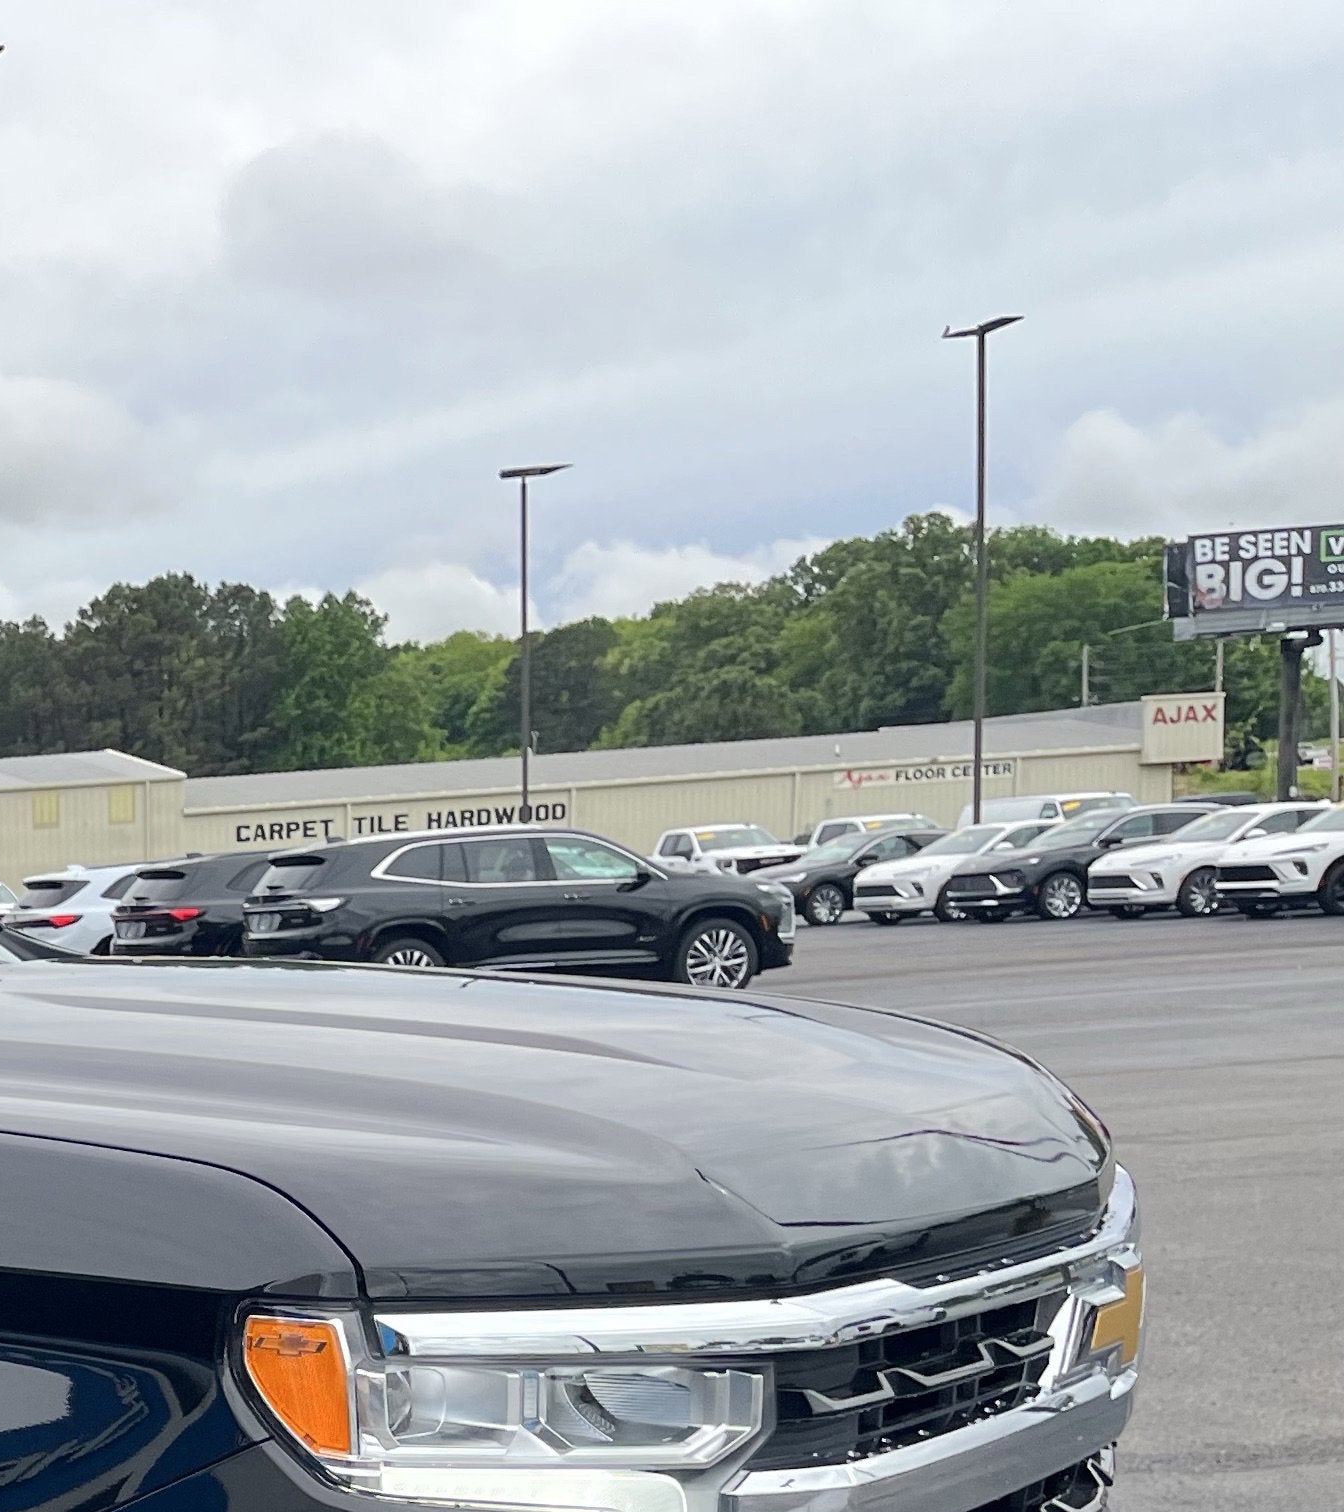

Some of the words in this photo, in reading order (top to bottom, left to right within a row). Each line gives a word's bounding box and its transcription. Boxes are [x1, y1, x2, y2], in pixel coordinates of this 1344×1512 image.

[1194, 537, 1230, 563] BE
[1238, 529, 1312, 559] SEEN
[1195, 556, 1304, 603] BIG!
[1153, 703, 1217, 725] AJAX
[895, 766, 947, 782] FLOOR
[951, 763, 1012, 777] CETER
[236, 819, 334, 843] CARPET
[353, 814, 410, 835] TILE
[427, 803, 567, 831] HARDWOD
